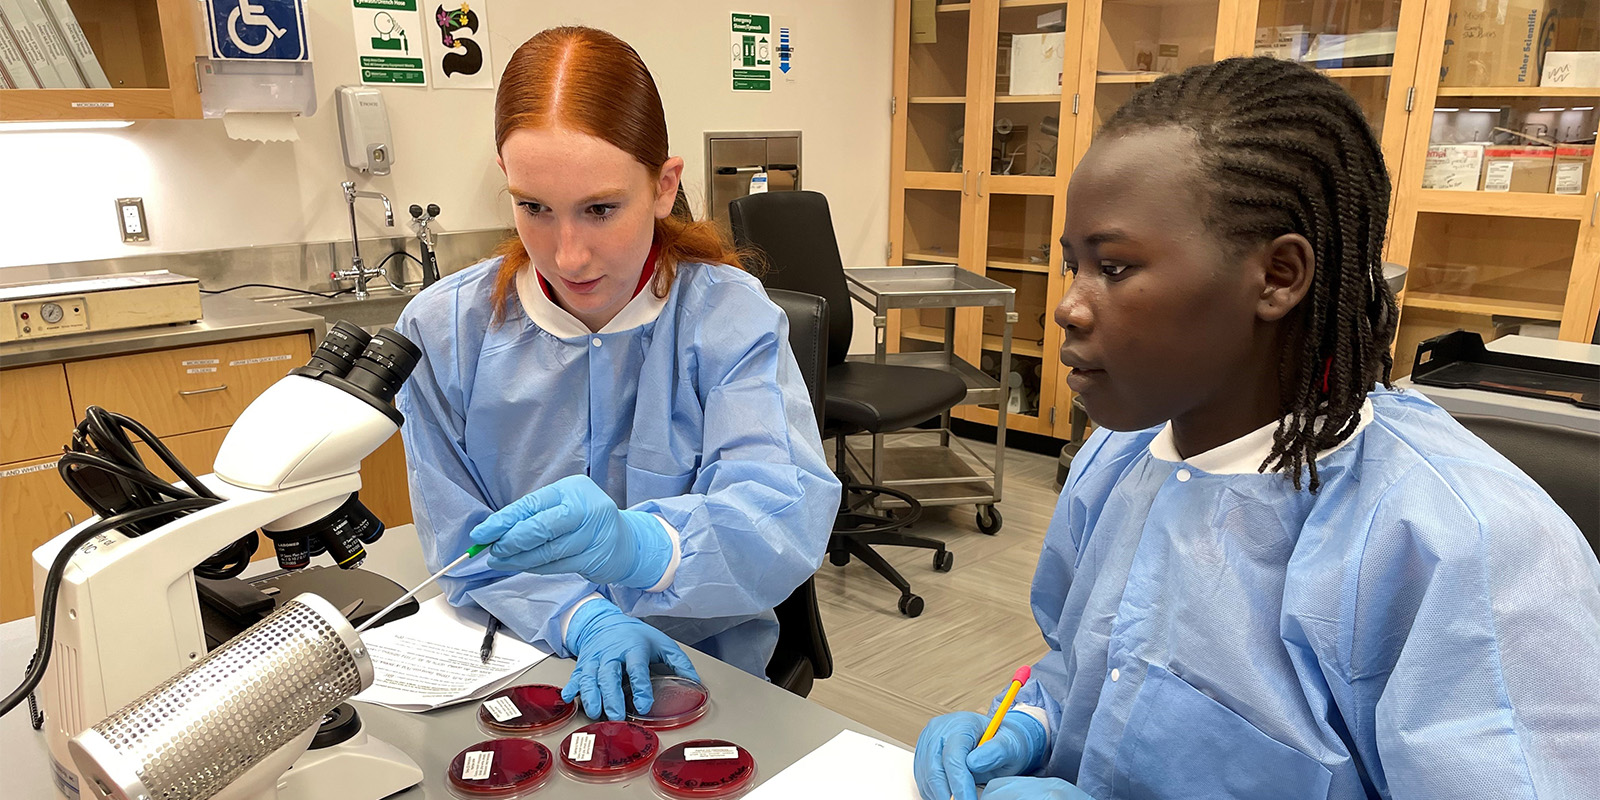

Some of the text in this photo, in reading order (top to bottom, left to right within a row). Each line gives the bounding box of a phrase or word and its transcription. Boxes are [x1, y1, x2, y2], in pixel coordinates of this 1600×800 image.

[733, 16, 752, 24] Emergency
[1518, 9, 1537, 82] Fisher Scientific
